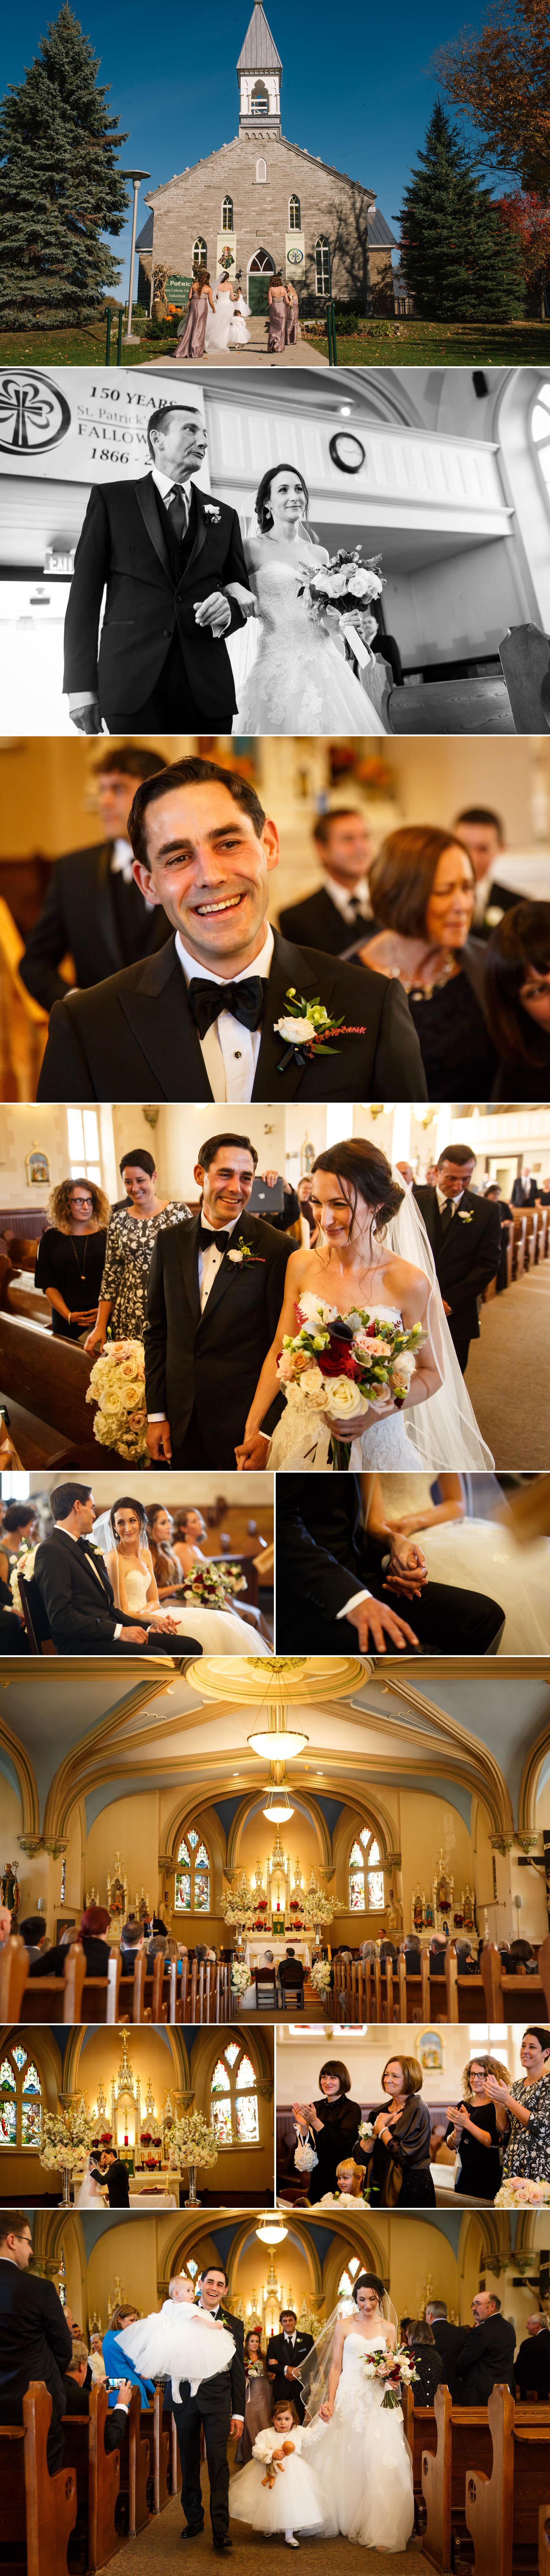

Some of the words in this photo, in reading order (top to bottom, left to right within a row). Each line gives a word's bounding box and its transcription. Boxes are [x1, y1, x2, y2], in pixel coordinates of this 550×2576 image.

[89, 386, 120, 402] 150
[77, 405, 94, 417] St.
[99, 408, 148, 425] Patrick'
[78, 424, 147, 444] FALLOW
[90, 448, 129, 464] 1866
